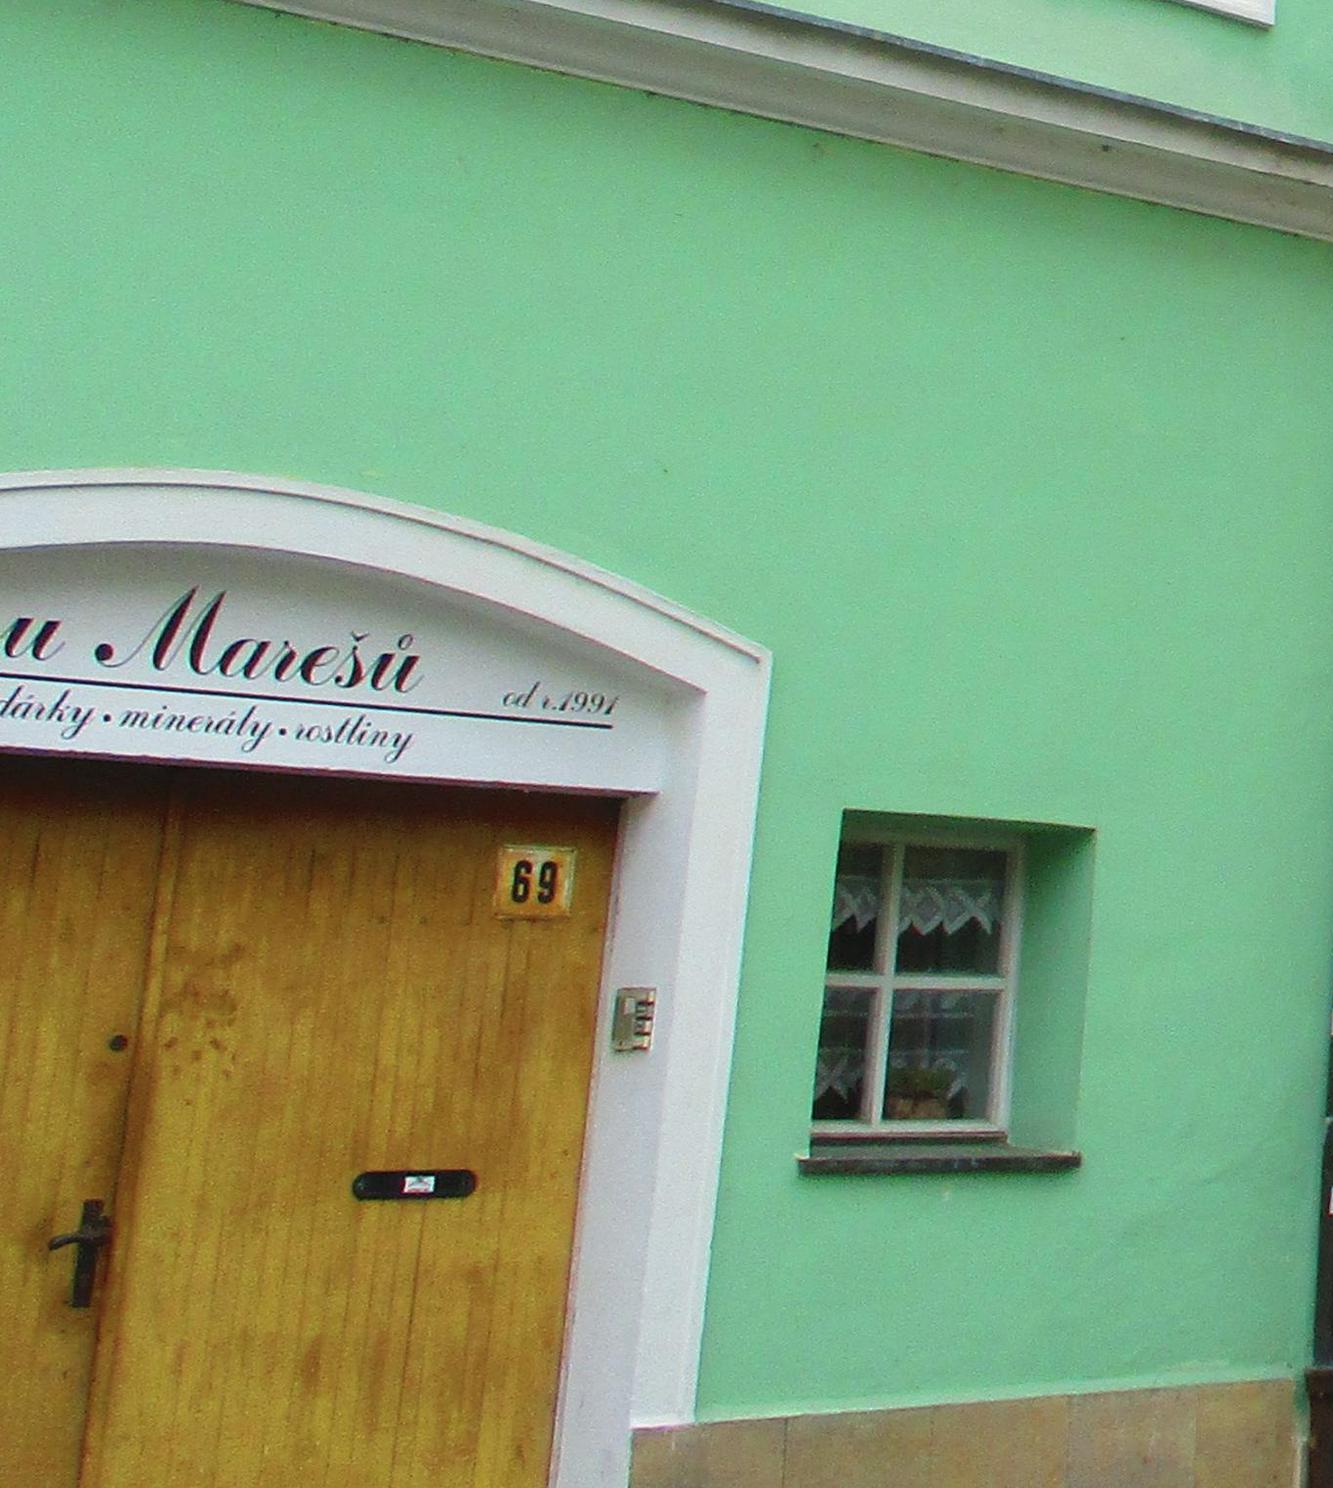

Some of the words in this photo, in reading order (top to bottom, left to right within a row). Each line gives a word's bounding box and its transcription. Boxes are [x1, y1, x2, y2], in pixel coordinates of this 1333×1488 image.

[93, 584, 425, 694] Marešů
[501, 680, 541, 708] od
[117, 702, 273, 754] minerály
[294, 714, 415, 764] rostliny
[511, 859, 559, 904] 69
